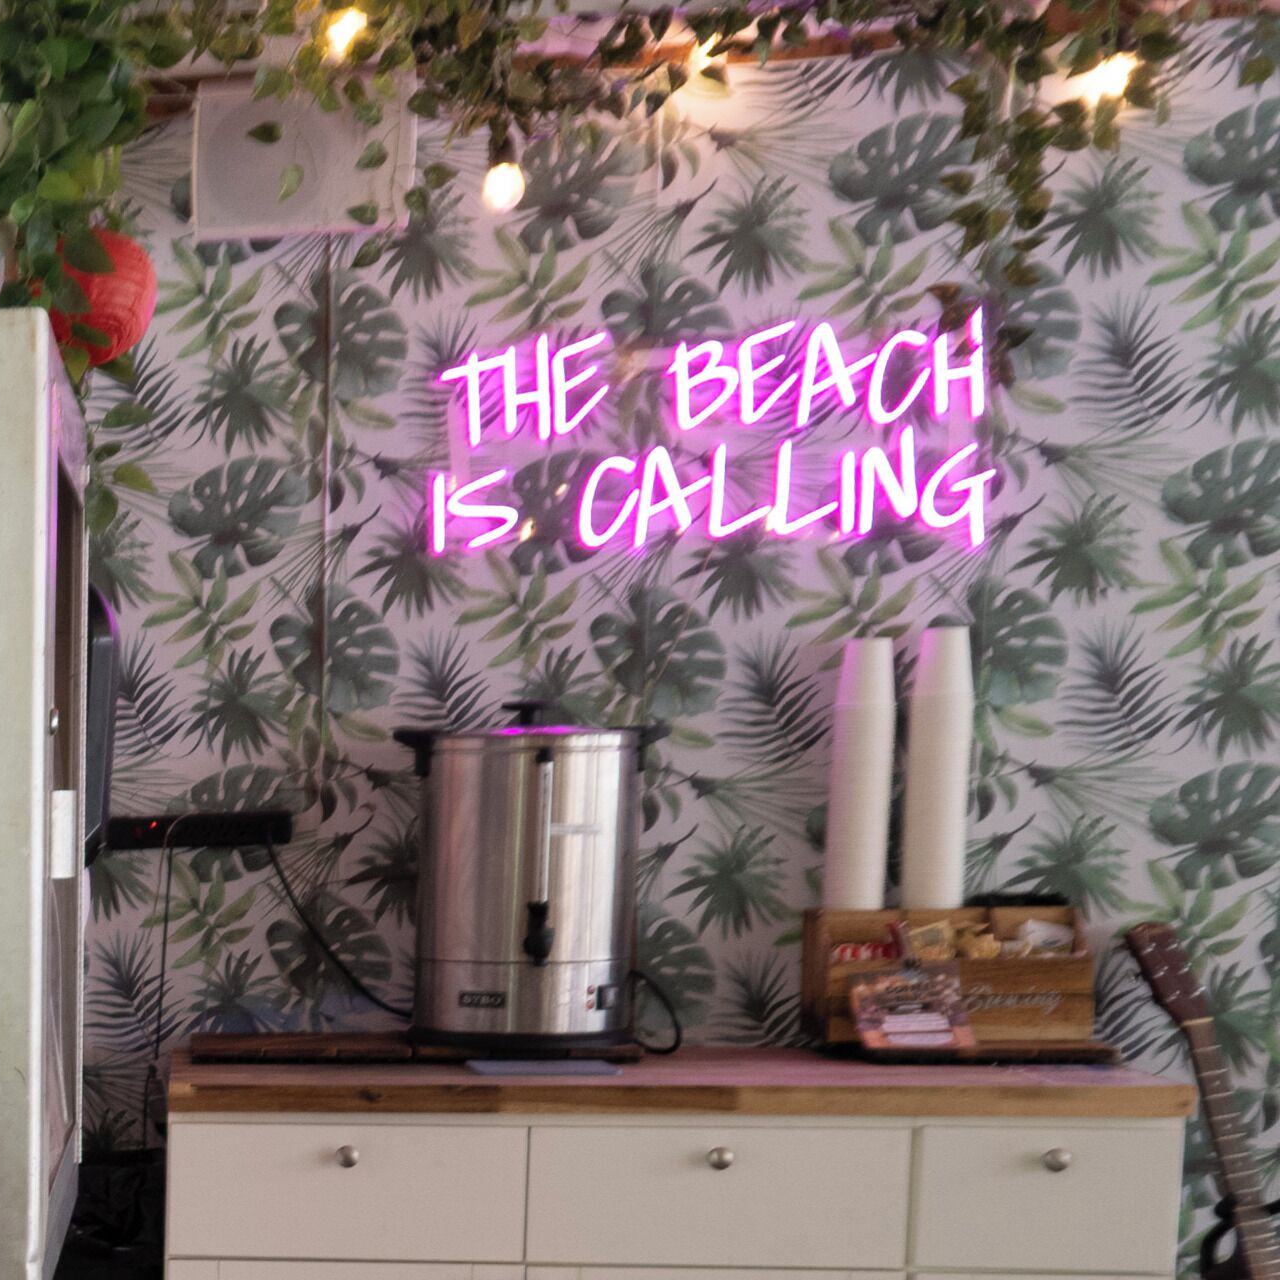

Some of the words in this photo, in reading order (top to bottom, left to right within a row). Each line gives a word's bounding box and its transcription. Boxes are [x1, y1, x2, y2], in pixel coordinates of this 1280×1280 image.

[439, 331, 608, 449] THE
[666, 305, 986, 431] BEACH
[430, 467, 519, 555] IS
[578, 427, 997, 549] CALLING
